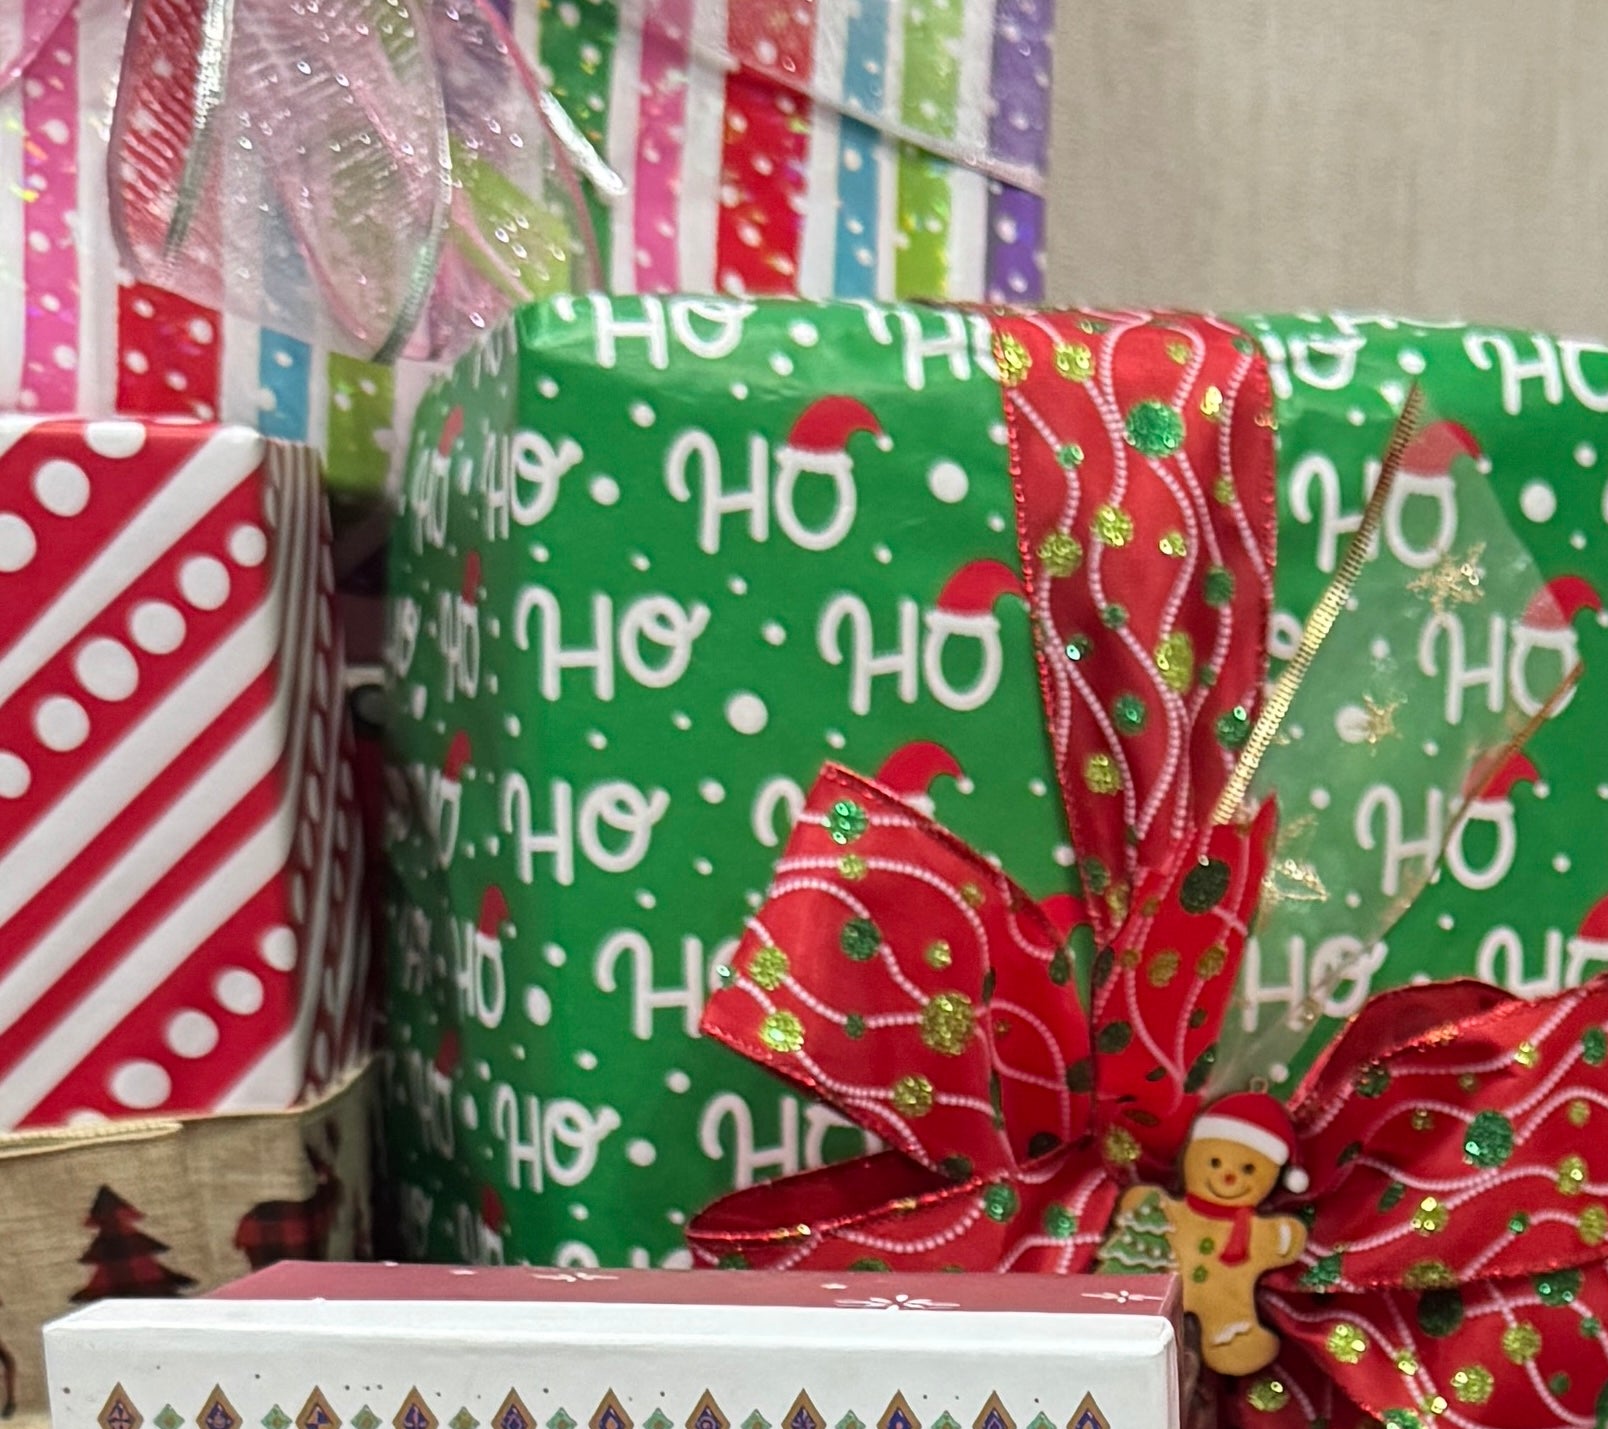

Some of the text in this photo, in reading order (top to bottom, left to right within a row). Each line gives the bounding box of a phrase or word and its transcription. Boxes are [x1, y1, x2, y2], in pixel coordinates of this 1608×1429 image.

[554, 292, 757, 370] HO
[480, 420, 584, 542] HO
[664, 430, 858, 554] HO
[1290, 456, 1458, 573] HO
[514, 584, 712, 702] HO
[818, 594, 1003, 716] HO
[1420, 614, 1582, 726] HO
[502, 771, 670, 886] HO
[1355, 784, 1517, 895] HO
[1242, 934, 1389, 1034] HO
[491, 1082, 622, 1195] HO
